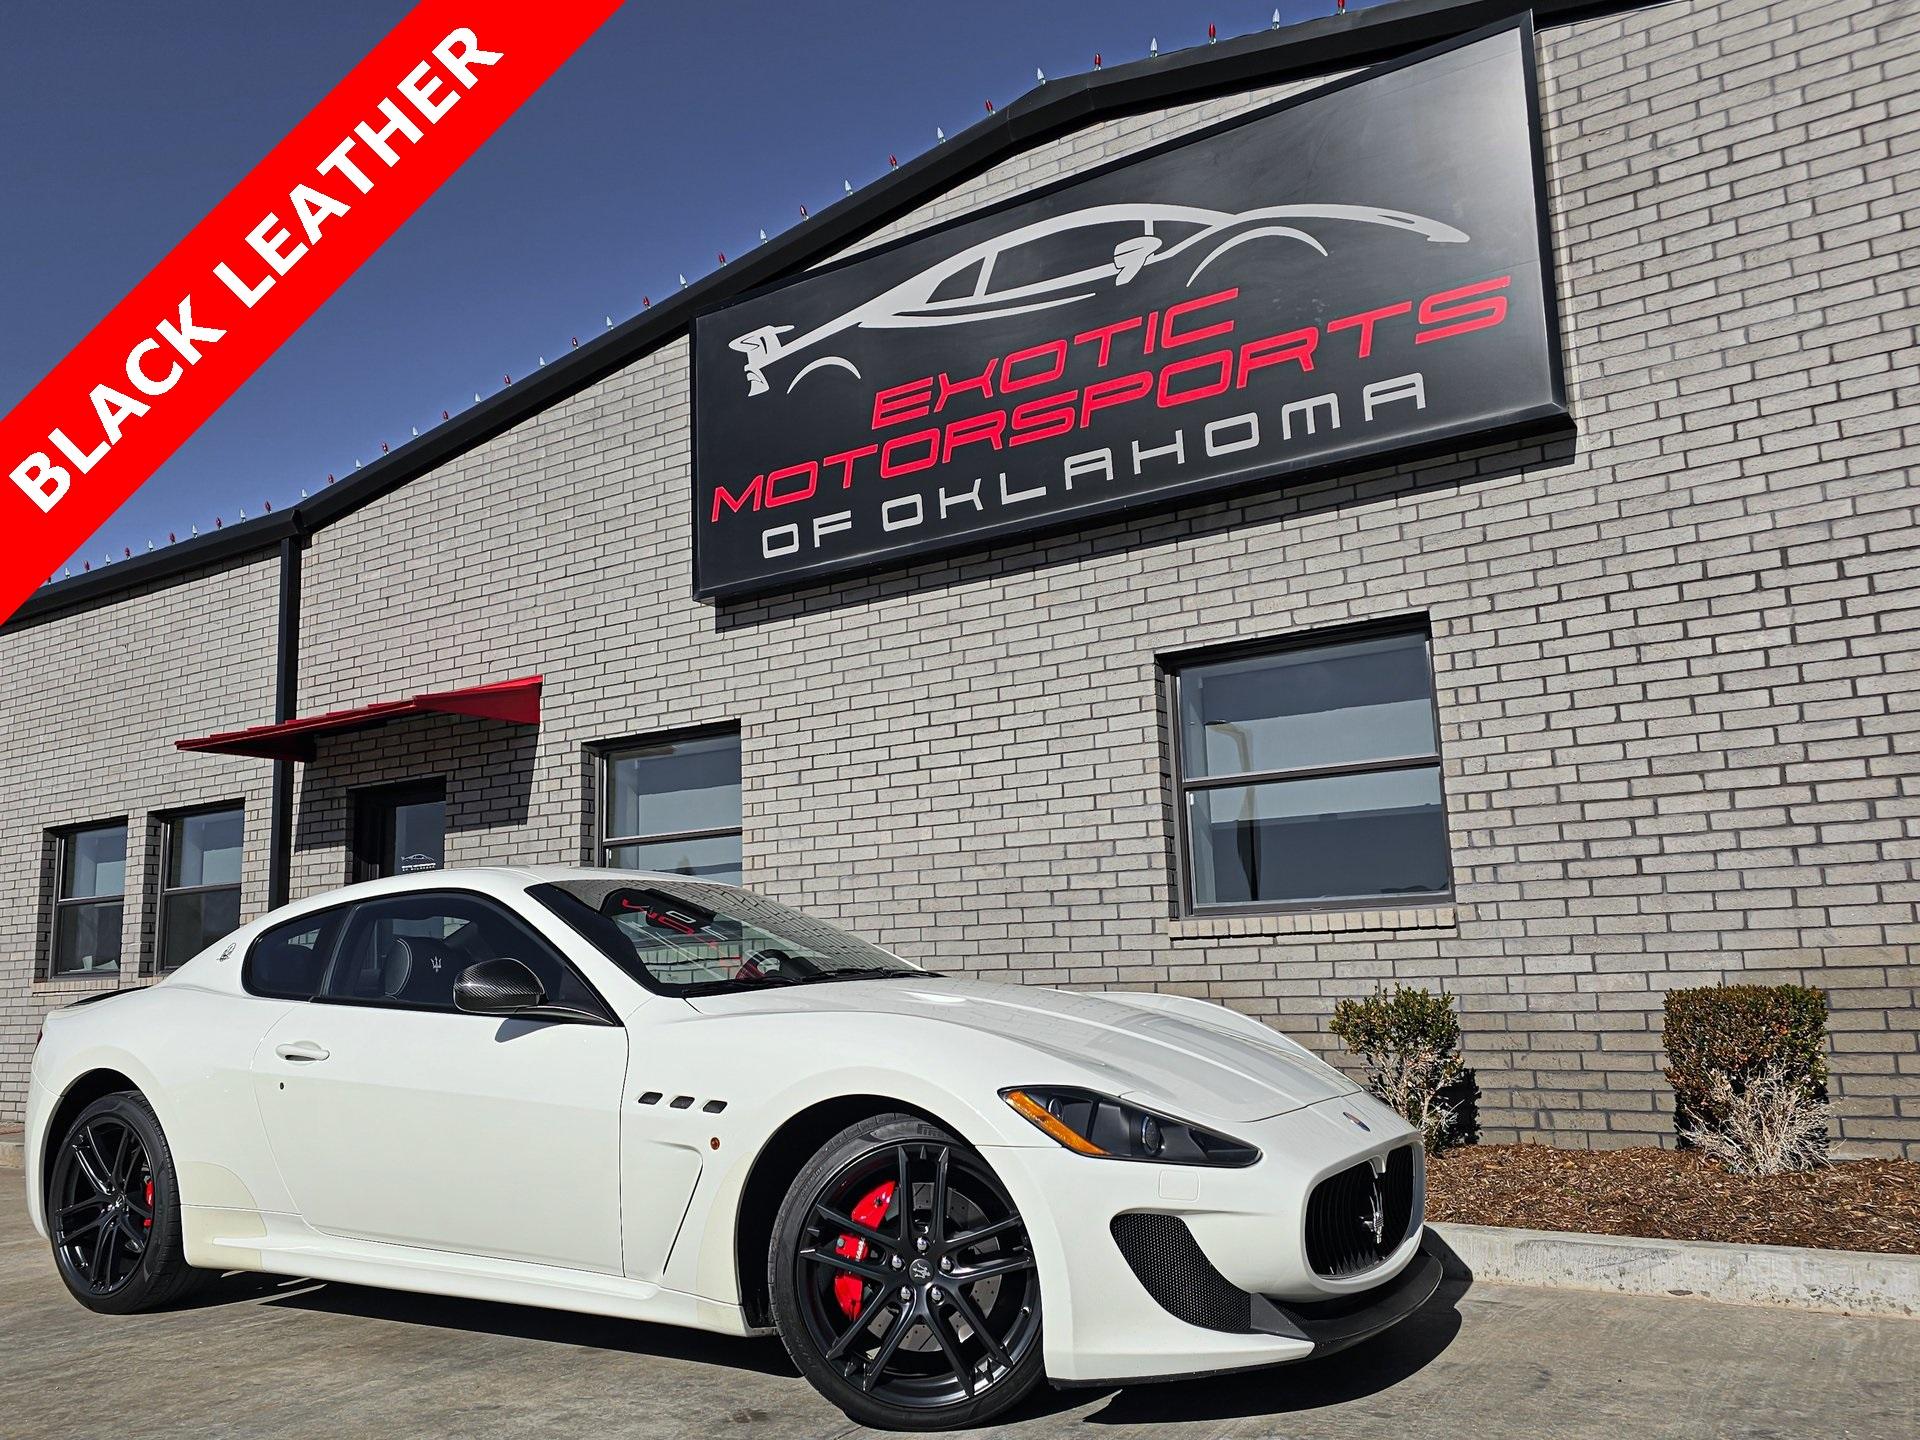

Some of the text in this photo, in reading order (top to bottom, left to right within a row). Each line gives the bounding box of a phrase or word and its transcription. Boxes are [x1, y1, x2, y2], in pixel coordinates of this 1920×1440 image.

[711, 275, 1512, 523] MOTORSPORTS
[872, 287, 1239, 430] EXOTIC
[762, 372, 1427, 559] OF OKLAHOMA
